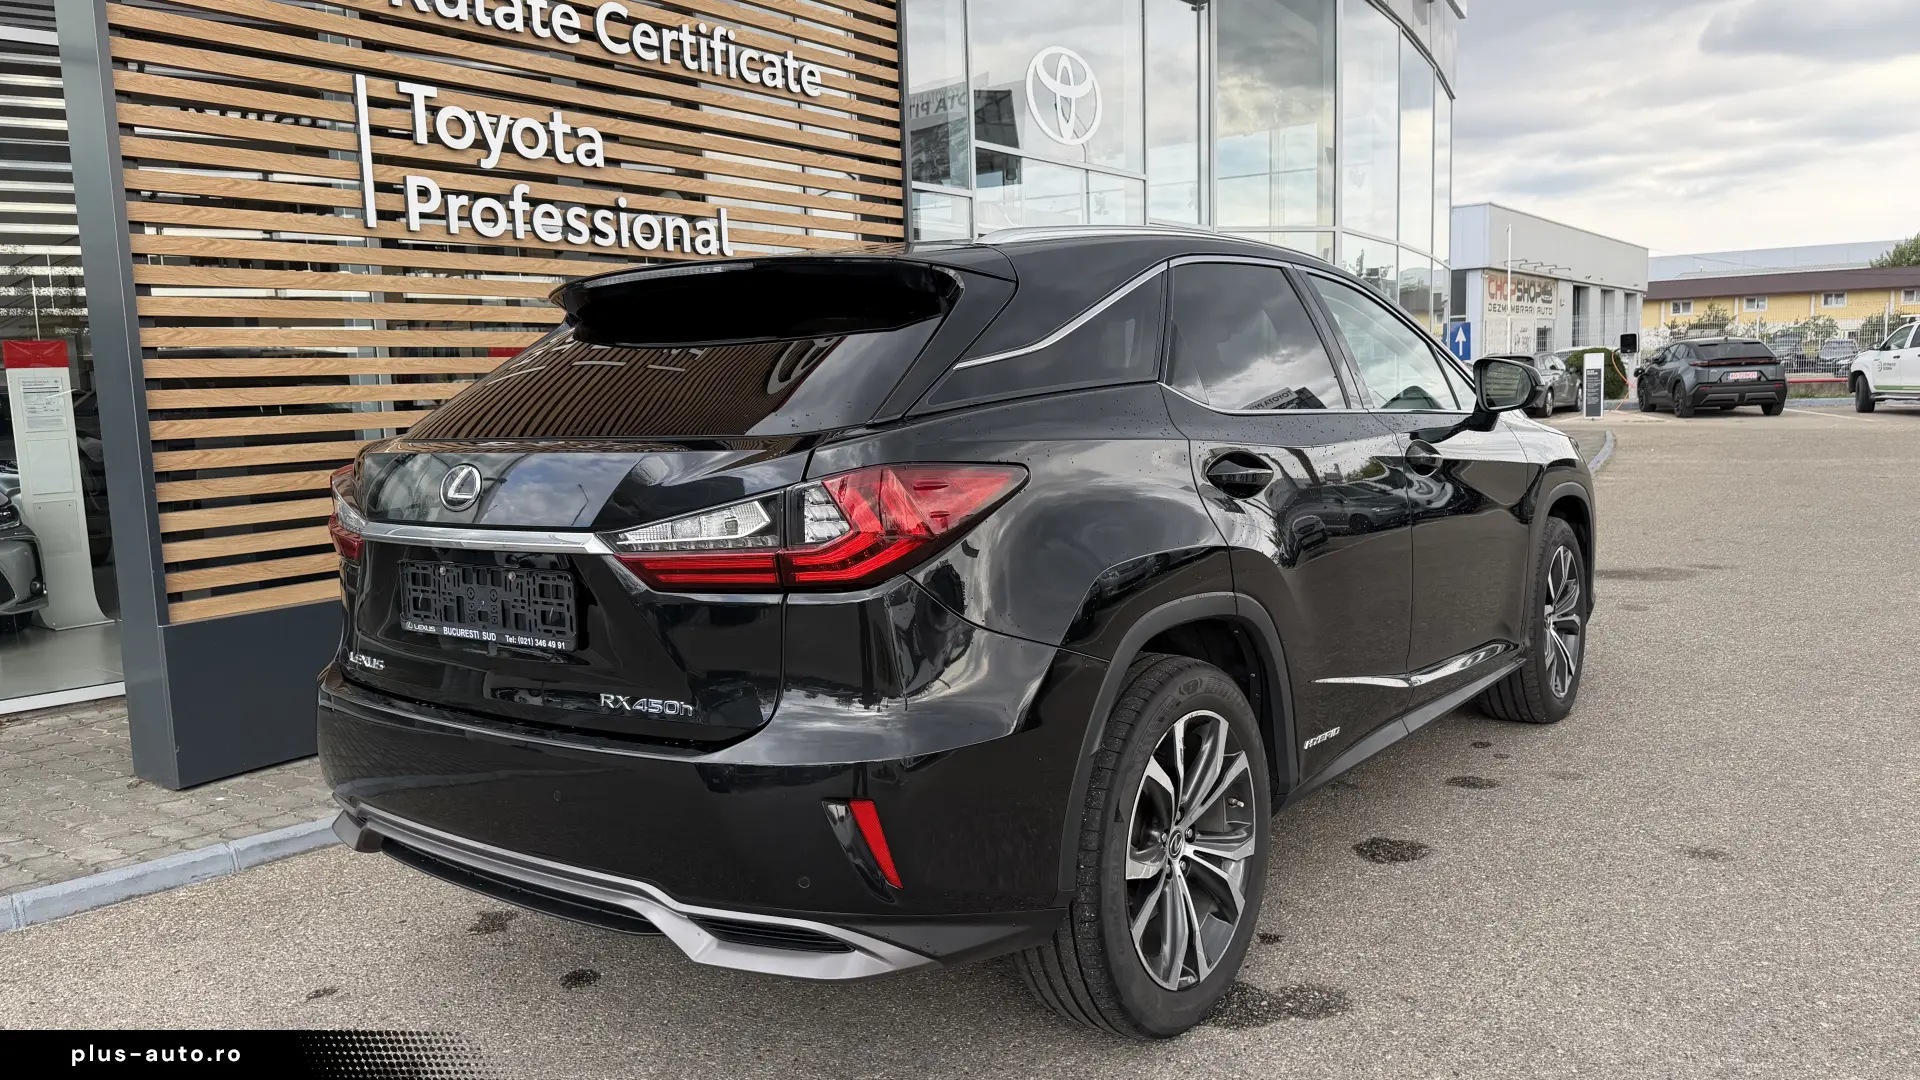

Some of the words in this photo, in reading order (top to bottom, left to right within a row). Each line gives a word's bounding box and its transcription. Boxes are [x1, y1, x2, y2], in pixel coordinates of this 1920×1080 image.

[594, 1, 822, 97] Certificate
[397, 81, 605, 169] Toyota
[404, 175, 733, 257] Professional
[350, 651, 385, 670] LEXUS
[413, 625, 436, 633] LEXUS
[443, 626, 480, 640] BUCURESTI
[482, 633, 497, 642] SUD
[505, 635, 517, 644] Tel:
[517, 636, 534, 647] (021)
[534, 638, 547, 648] 346
[547, 640, 557, 649] 49
[557, 641, 566, 650] 91
